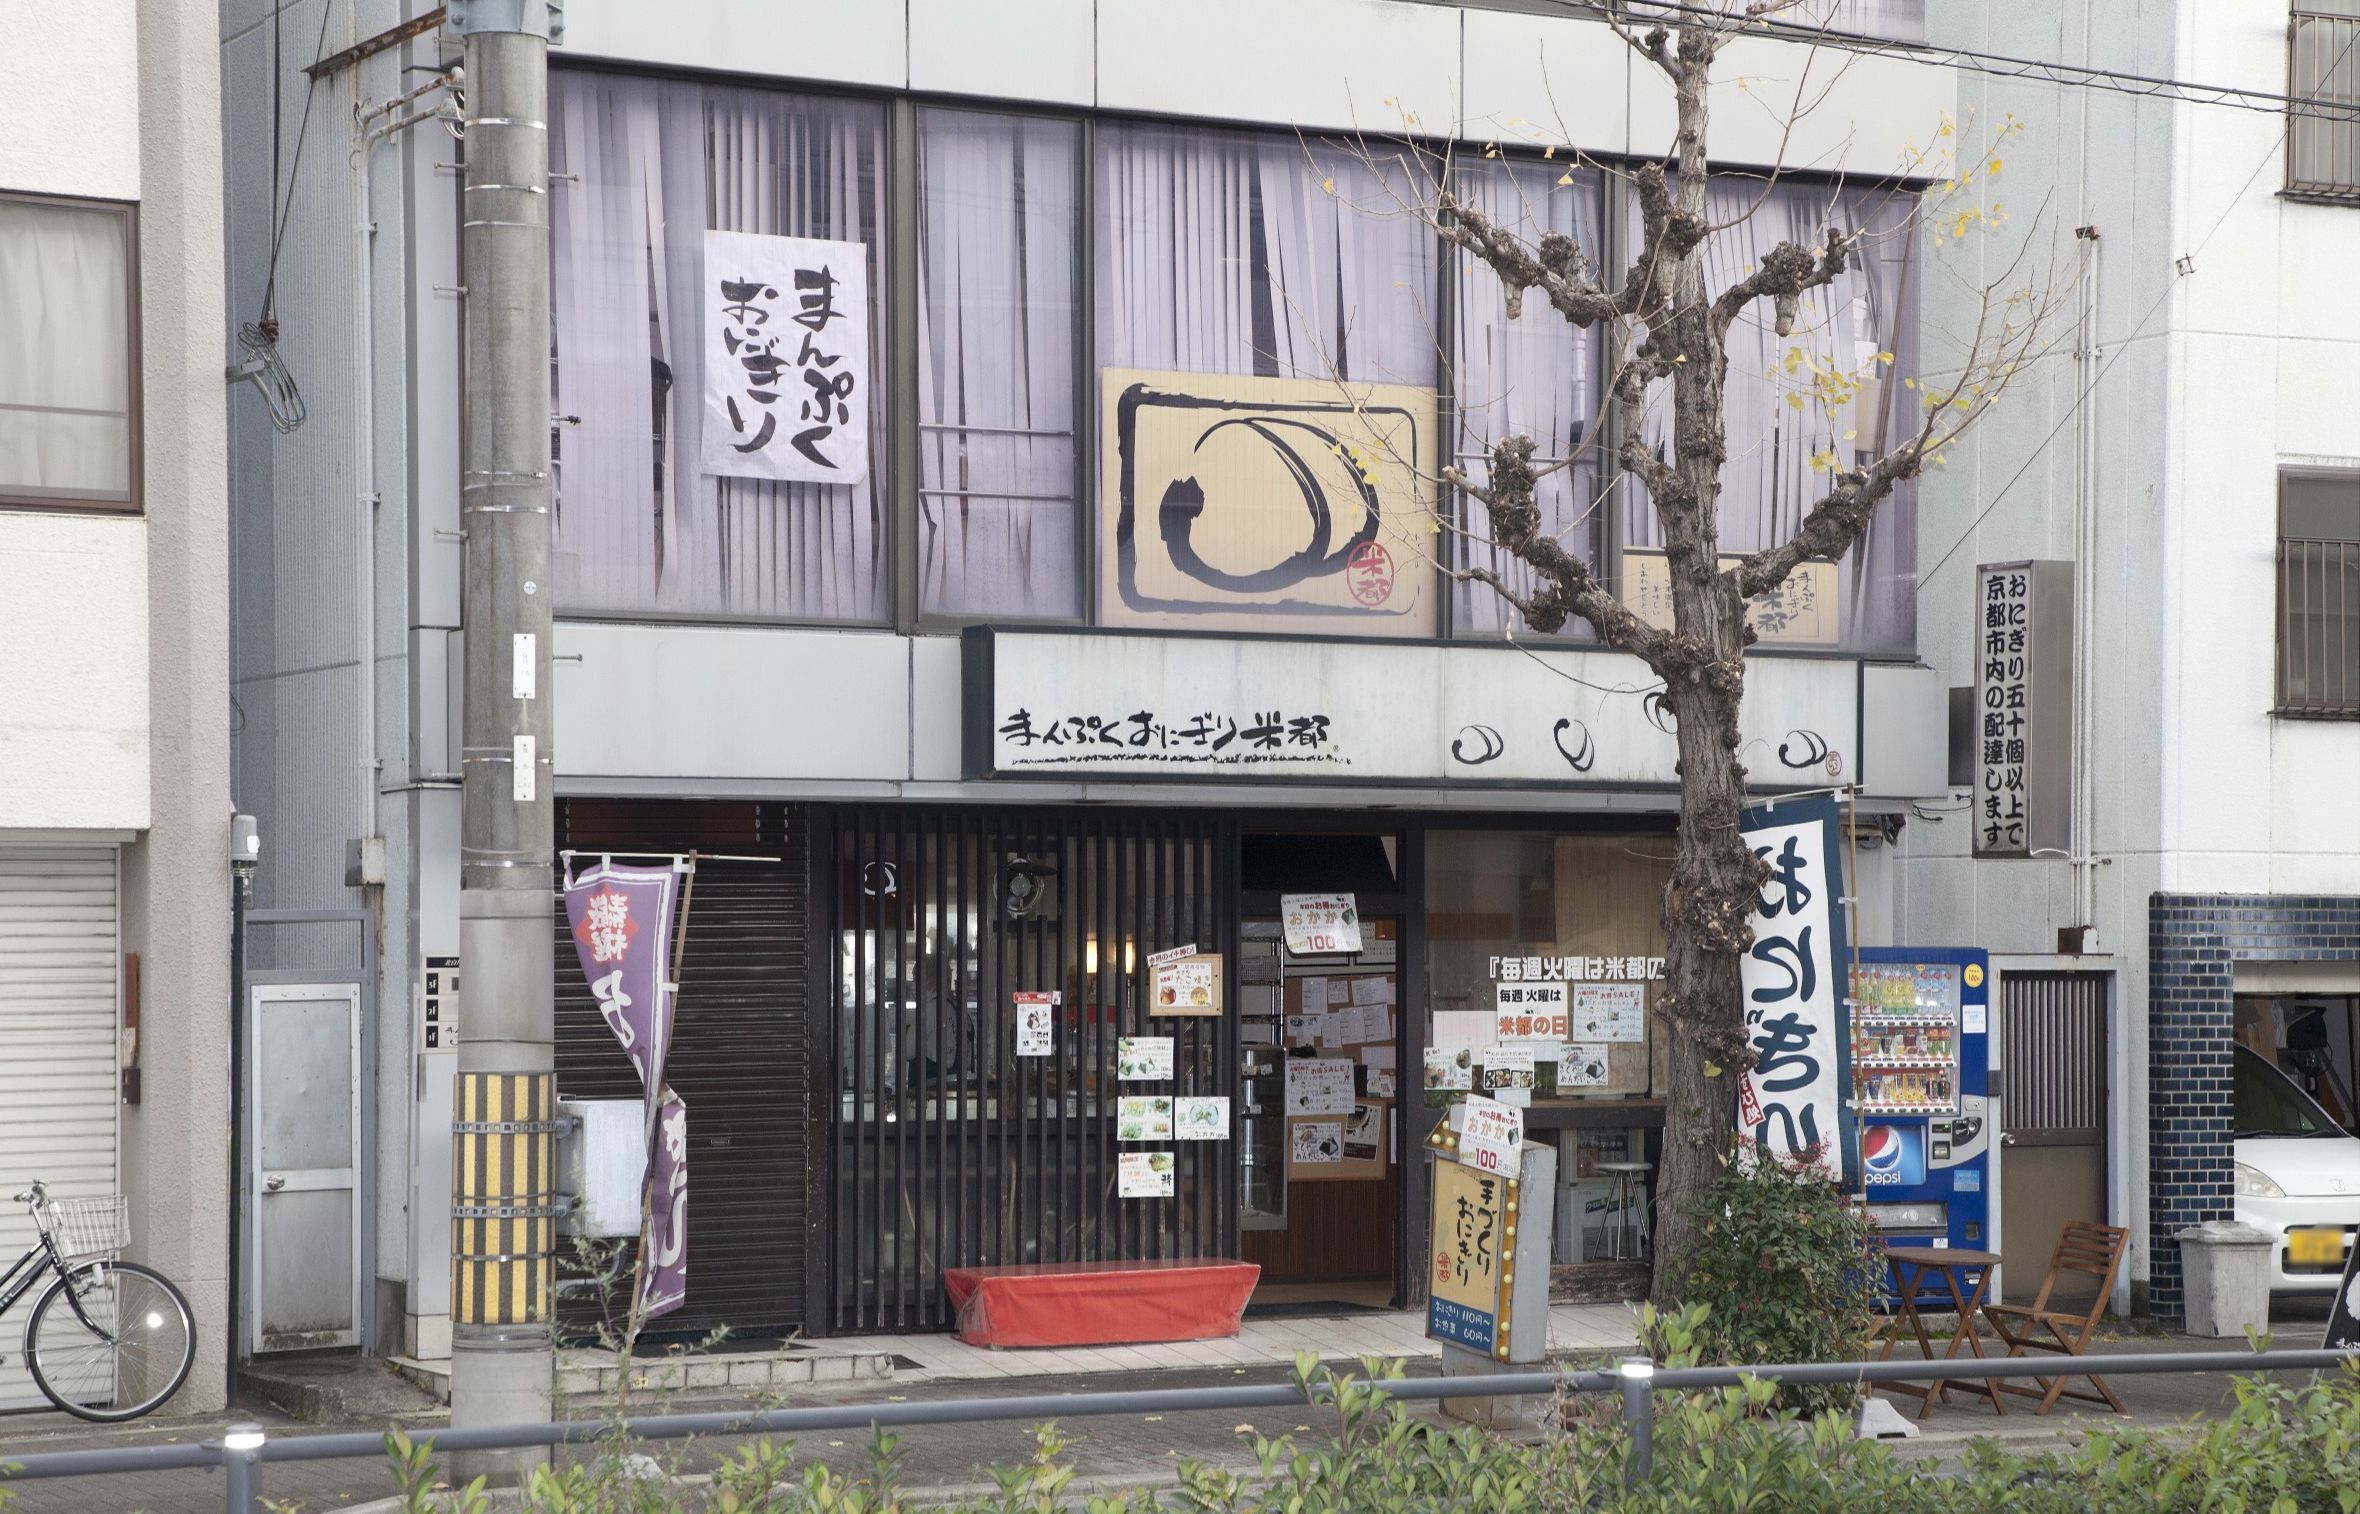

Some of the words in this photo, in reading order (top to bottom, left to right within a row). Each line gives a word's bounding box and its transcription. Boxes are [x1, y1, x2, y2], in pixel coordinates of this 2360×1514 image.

[720, 275, 791, 454] おにぎり
[790, 264, 855, 470] まんぷく
[1796, 570, 1815, 612] まんぷく
[1983, 574, 2006, 847] 京都市内の配達します
[2006, 574, 2027, 846] おにぎり五十個以上で
[1289, 910, 1338, 926] おかか
[1499, 989, 1523, 1003] 毎週
[1526, 989, 1562, 1003] 火曜は
[1499, 1015, 1568, 1036] 米都の日
[1467, 1116, 1505, 1140] おかか
[1456, 1195, 1475, 1288] おにぎり
[1477, 1180, 1498, 1277] 手づくり
